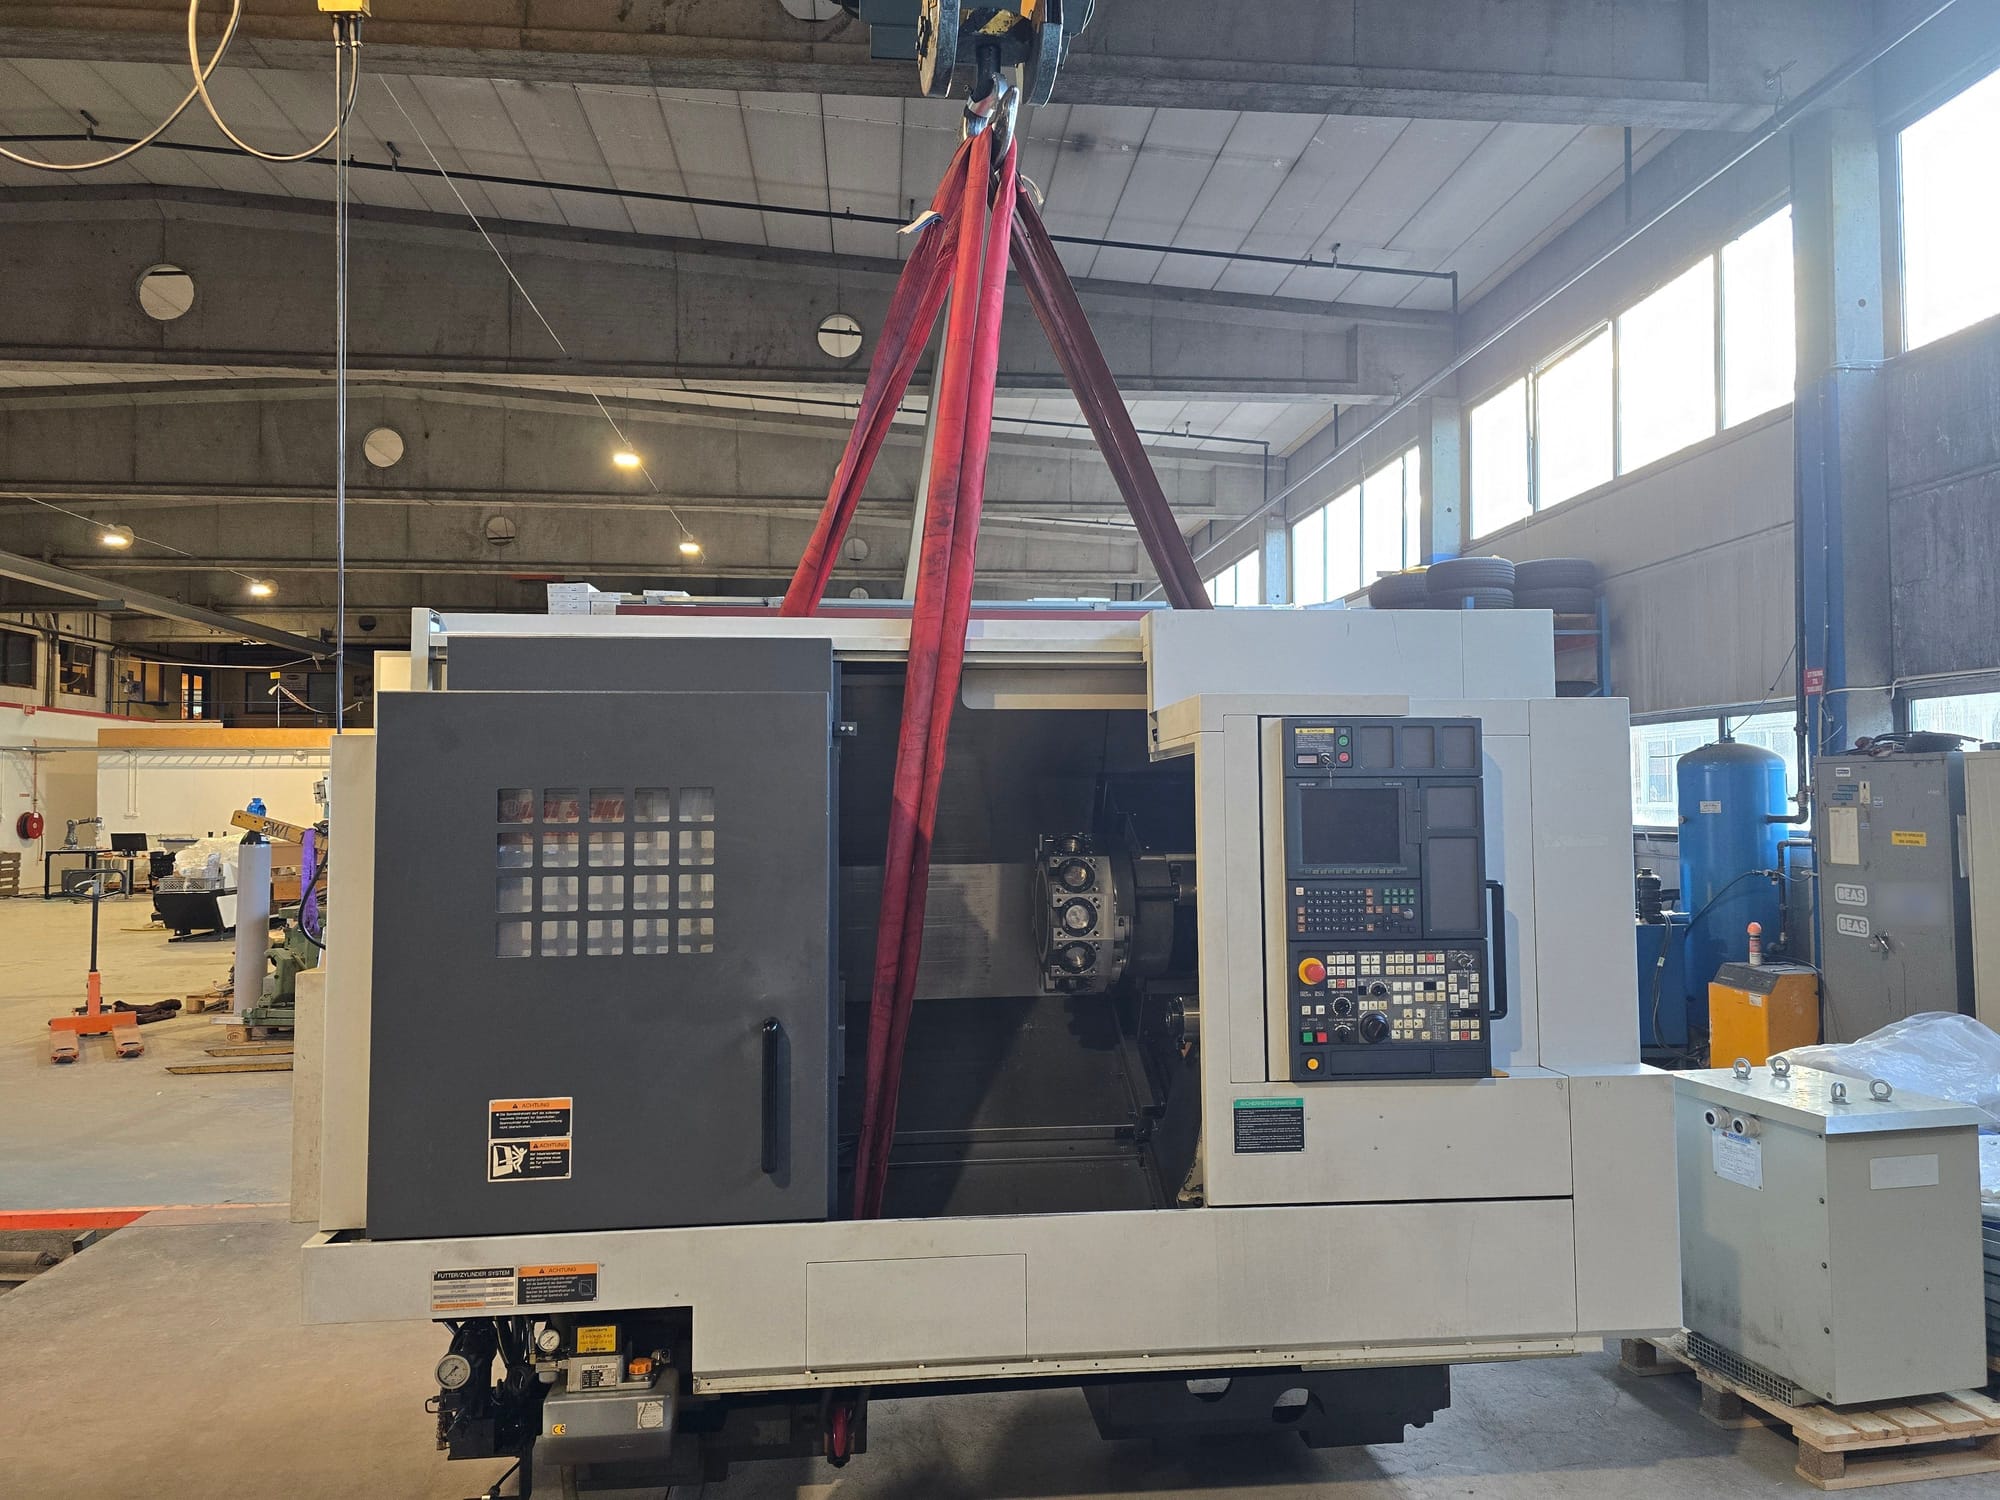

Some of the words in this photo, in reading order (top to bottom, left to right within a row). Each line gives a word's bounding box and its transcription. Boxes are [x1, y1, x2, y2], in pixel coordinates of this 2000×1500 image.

[1838, 888, 1864, 901] BEAS
[1840, 918, 1866, 934] BEAS
[437, 1270, 487, 1279] FUTTER/ZYLINDER
[488, 1269, 510, 1277] SYSTEM
